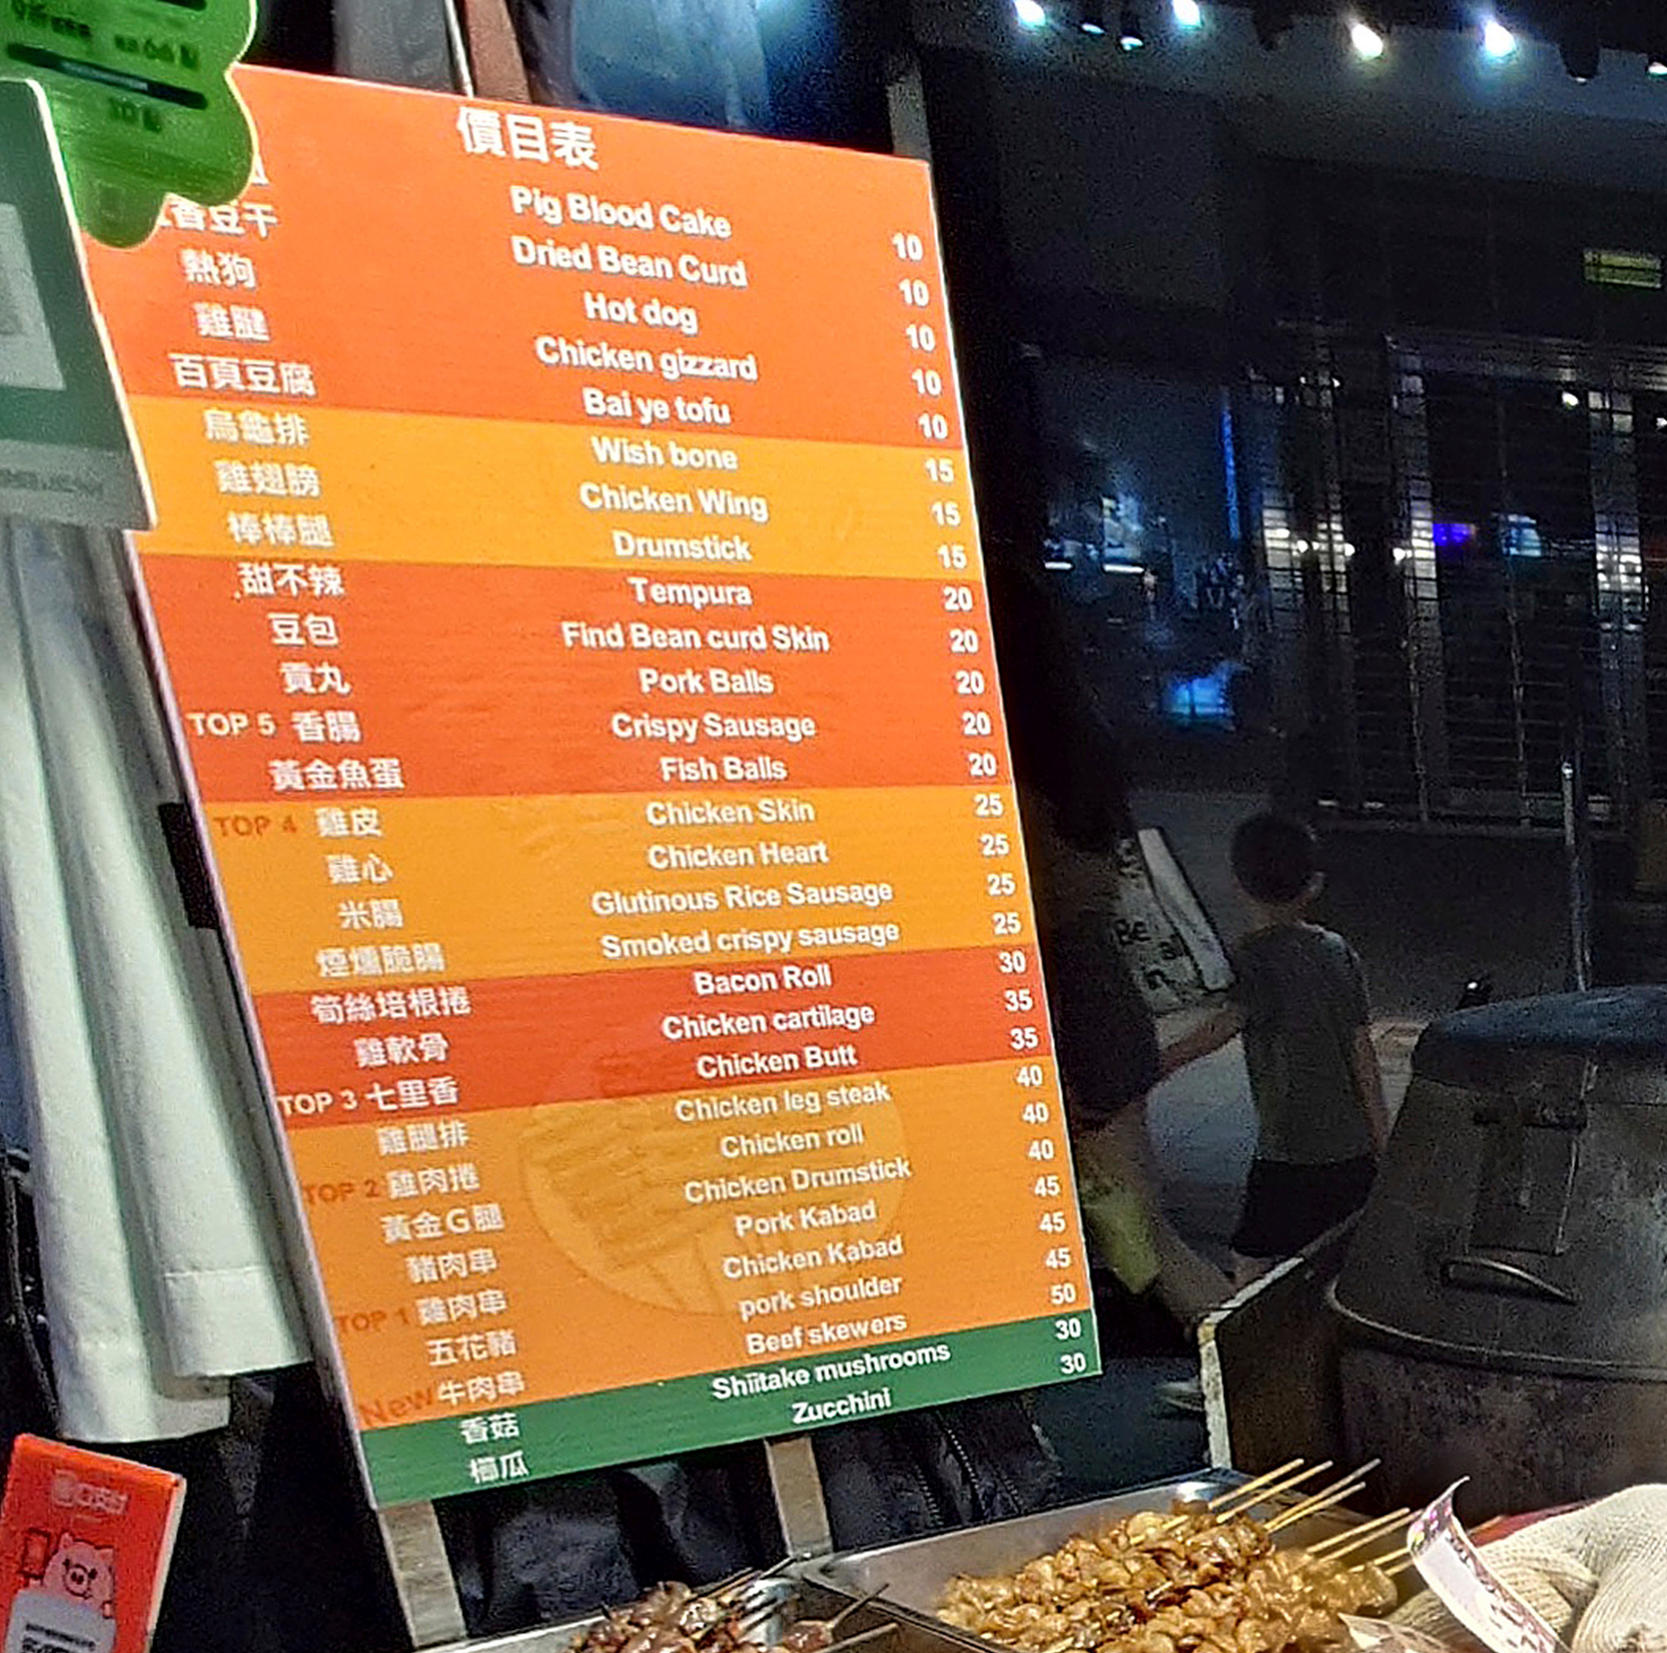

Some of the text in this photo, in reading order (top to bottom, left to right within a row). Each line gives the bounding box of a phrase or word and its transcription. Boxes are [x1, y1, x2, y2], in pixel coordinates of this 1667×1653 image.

[456, 105, 598, 171] 價目表
[159, 199, 278, 239] 香豆干
[510, 185, 733, 239] Pig Blood Cake
[511, 234, 748, 288] Dried Bean Curd
[891, 234, 923, 261] 10
[180, 249, 258, 289] 熱狗
[898, 279, 930, 307] 10
[583, 292, 698, 336] Hot dog
[906, 325, 936, 352] 10
[168, 352, 317, 398] 百頁豆腐
[534, 335, 758, 383] Chicken gizzard
[912, 368, 942, 396] 10
[583, 387, 732, 426] Bai ye tofu
[918, 413, 948, 440] 10
[591, 435, 739, 472] Wish bone
[214, 459, 321, 498] 雞翅膀
[925, 458, 955, 484] 15
[580, 482, 769, 523] Chicken Wing
[931, 502, 962, 527] 15
[226, 511, 335, 549] 棒棒腿
[612, 530, 753, 563] Drumstick
[937, 544, 967, 570] 15
[237, 561, 345, 598] 甜不辣
[628, 576, 753, 610] Tempura
[943, 586, 974, 612] 20
[267, 612, 340, 648] 豆包
[561, 621, 830, 652] Find Bean curd Skin
[950, 628, 980, 654] 20
[279, 661, 351, 695] 貢丸
[639, 668, 775, 695] Pork Balls
[956, 670, 986, 695] 20
[187, 712, 277, 736] TOP 5
[291, 710, 362, 744] 香腸
[611, 714, 817, 742] Crispy Sausage
[962, 711, 992, 736] 20
[268, 758, 405, 792] 黃金魚蛋
[660, 755, 788, 782] Fish Balls
[968, 753, 998, 778] 20
[314, 807, 384, 838] 雞皮
[645, 800, 815, 827] Chicken Skin
[974, 794, 1003, 818] 25
[213, 815, 298, 837] TOP 4
[648, 840, 829, 869] Chicken Heart
[980, 833, 1010, 858] 25
[326, 853, 394, 886] 雞心
[987, 872, 1016, 897] 25
[338, 898, 404, 931] 米腸
[591, 881, 893, 916] Glutinous Rice Sausage
[601, 921, 900, 959] Smoked crispy sausage
[993, 912, 1022, 936] 25
[999, 950, 1027, 974] 30
[694, 965, 832, 995] Bacon Roll
[1004, 988, 1033, 1012] 35
[661, 1004, 875, 1040] Chicken cartilage
[1010, 1026, 1039, 1050] 35
[352, 1032, 449, 1069] 雞軟骨
[696, 1045, 859, 1080] Chicken Butt
[1016, 1065, 1043, 1088] 40
[276, 1091, 359, 1117] TOP 3
[365, 1076, 459, 1112] 七里香
[674, 1082, 891, 1124] Chicken leg steak
[1022, 1102, 1050, 1124] 40
[376, 1119, 469, 1156] 雞腿排
[720, 1123, 864, 1160] Chicken roll
[1028, 1138, 1055, 1161] 40
[684, 1157, 912, 1205] Chicken Drumstick
[1034, 1175, 1061, 1197] 45
[735, 1200, 877, 1238] Pork Kabad
[1039, 1211, 1067, 1234] 45
[722, 1236, 904, 1279] Chicken Kabad
[1045, 1248, 1072, 1270] 45
[415, 1288, 507, 1327] 雞肉串
[738, 1276, 903, 1322] pork shoulder
[1050, 1282, 1077, 1305] 50
[745, 1313, 908, 1356] Beef skewers
[1055, 1318, 1083, 1341] 30
[711, 1342, 951, 1401] Shiitake mushrooms
[1060, 1353, 1088, 1375] 30
[437, 1370, 525, 1408] 牛肉串
[792, 1388, 892, 1425] Zucchini
[459, 1411, 520, 1445] 香菇
